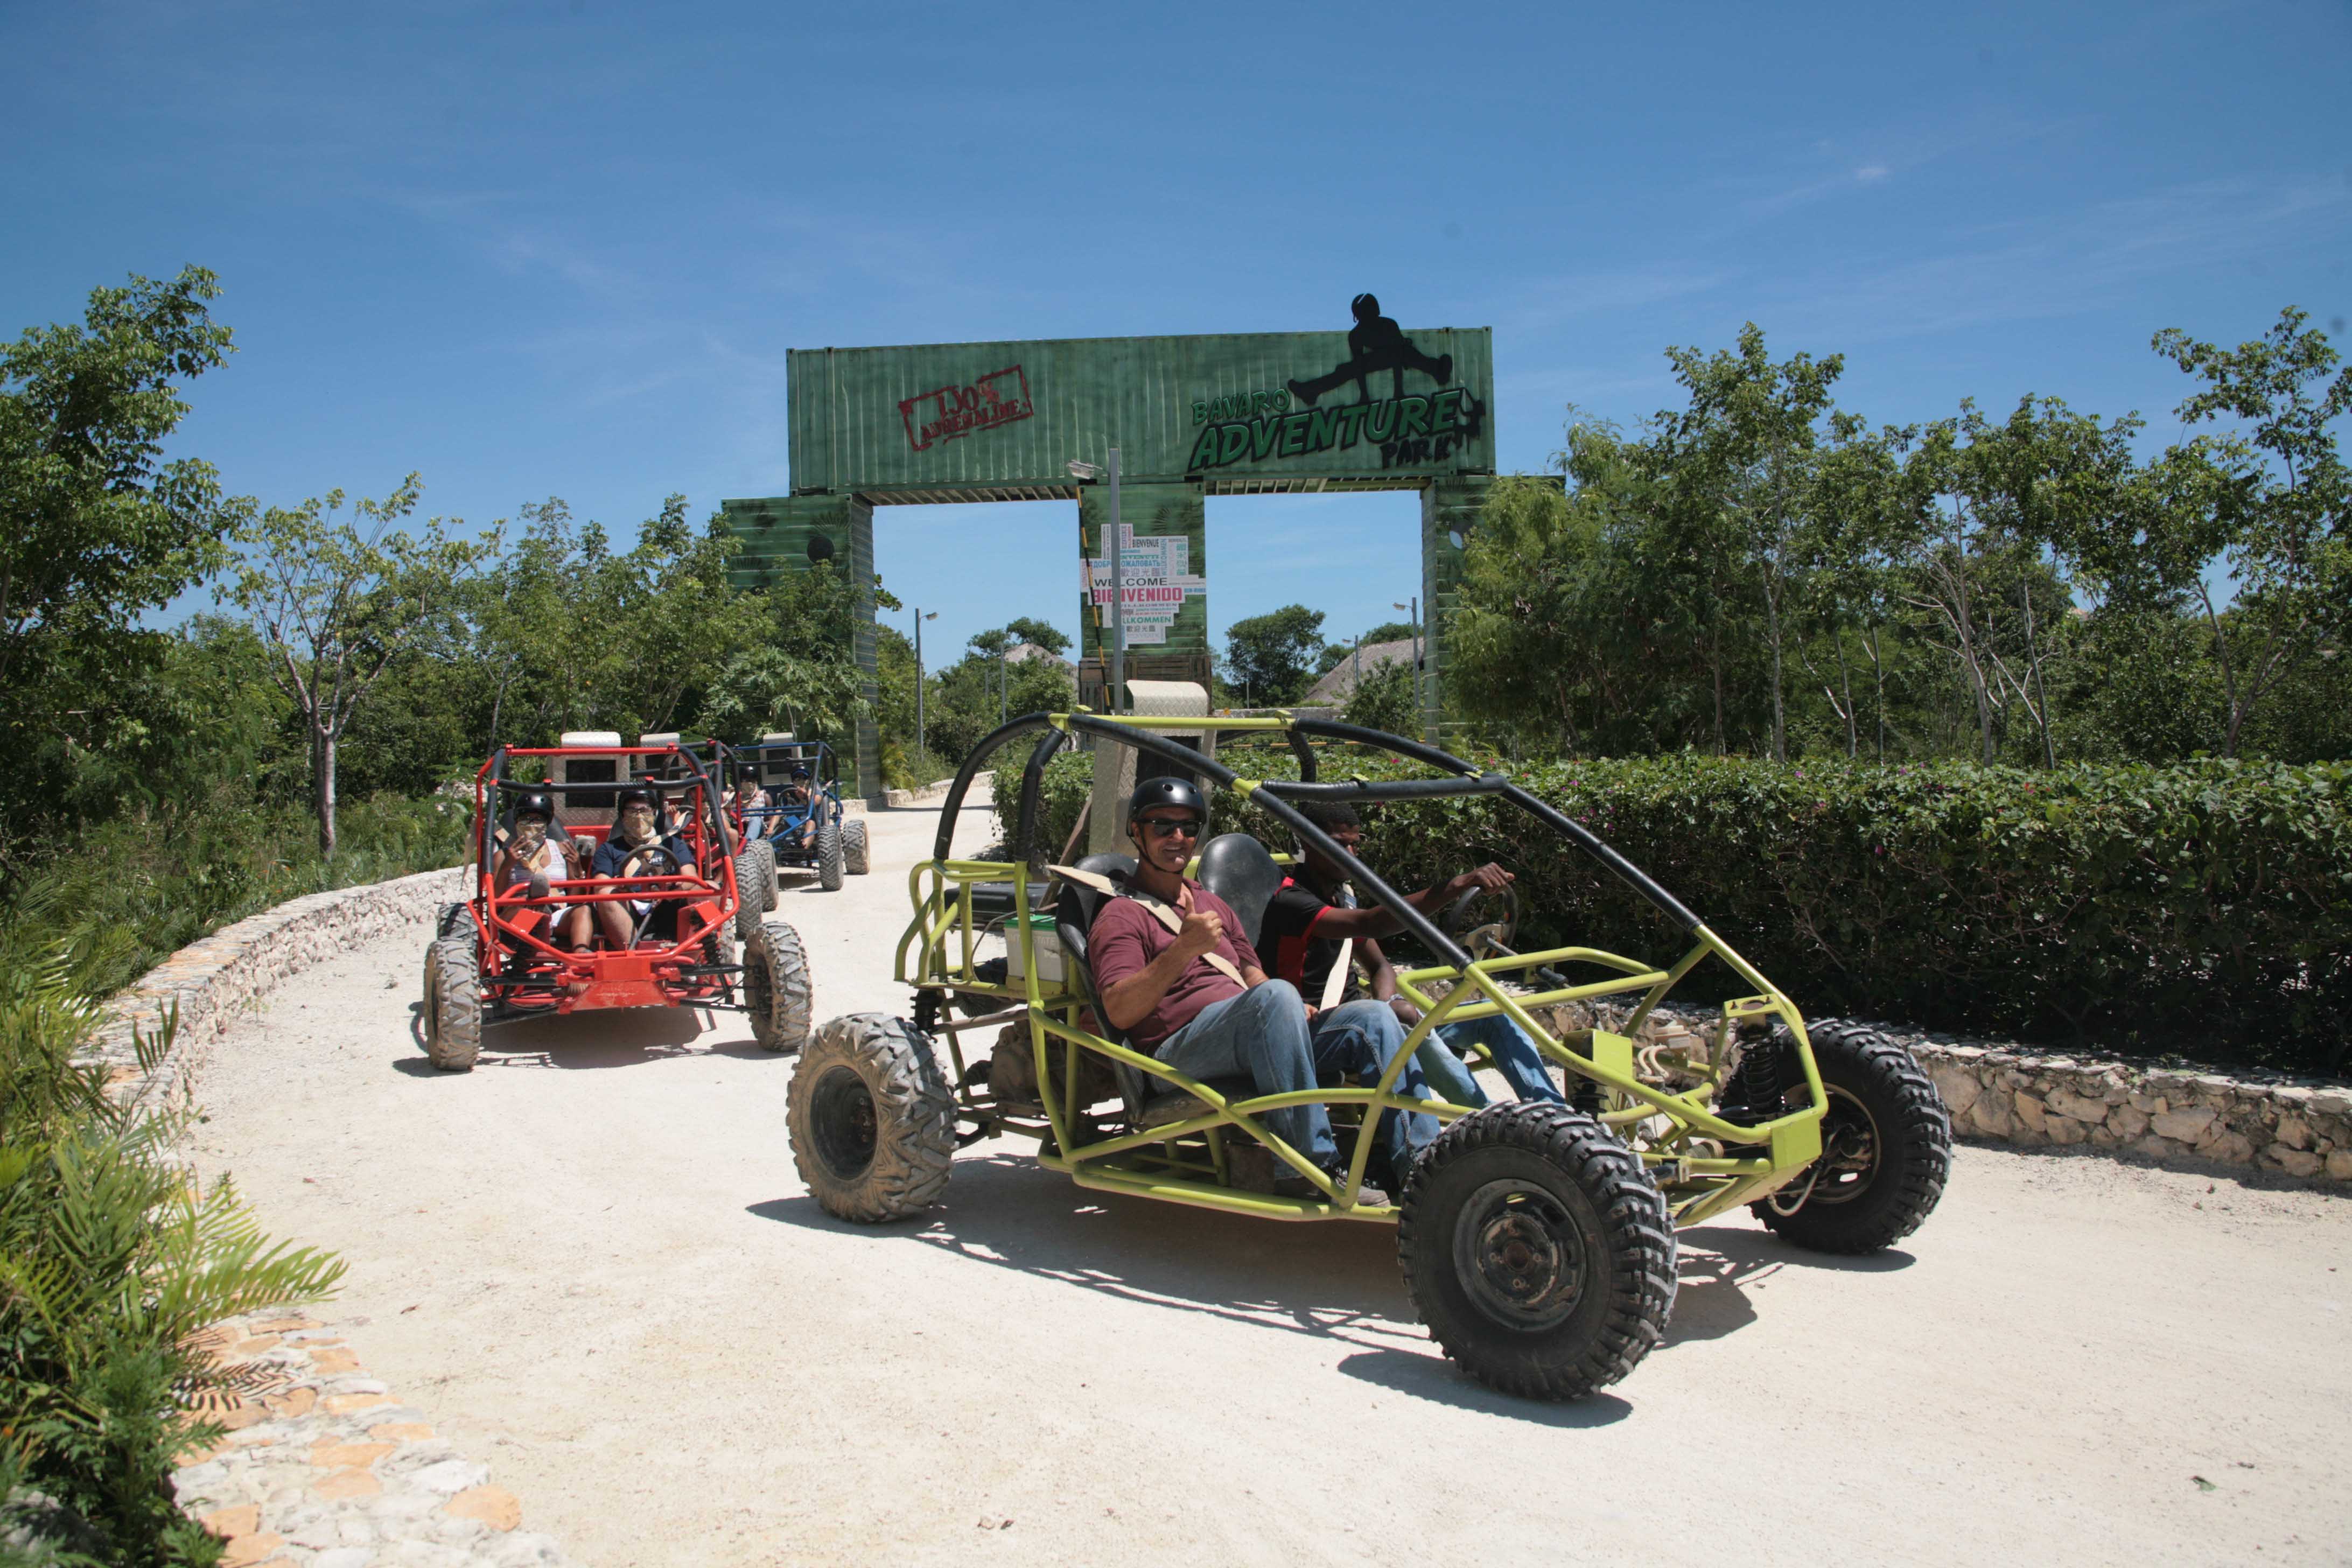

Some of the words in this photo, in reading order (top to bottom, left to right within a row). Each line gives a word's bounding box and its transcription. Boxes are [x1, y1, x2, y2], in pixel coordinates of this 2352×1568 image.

[1192, 388, 1290, 426] BAVARO
[1188, 388, 1467, 472] ADVENTURE
[1380, 434, 1451, 470] PARK
[1132, 538, 1159, 548] BIENVENUE
